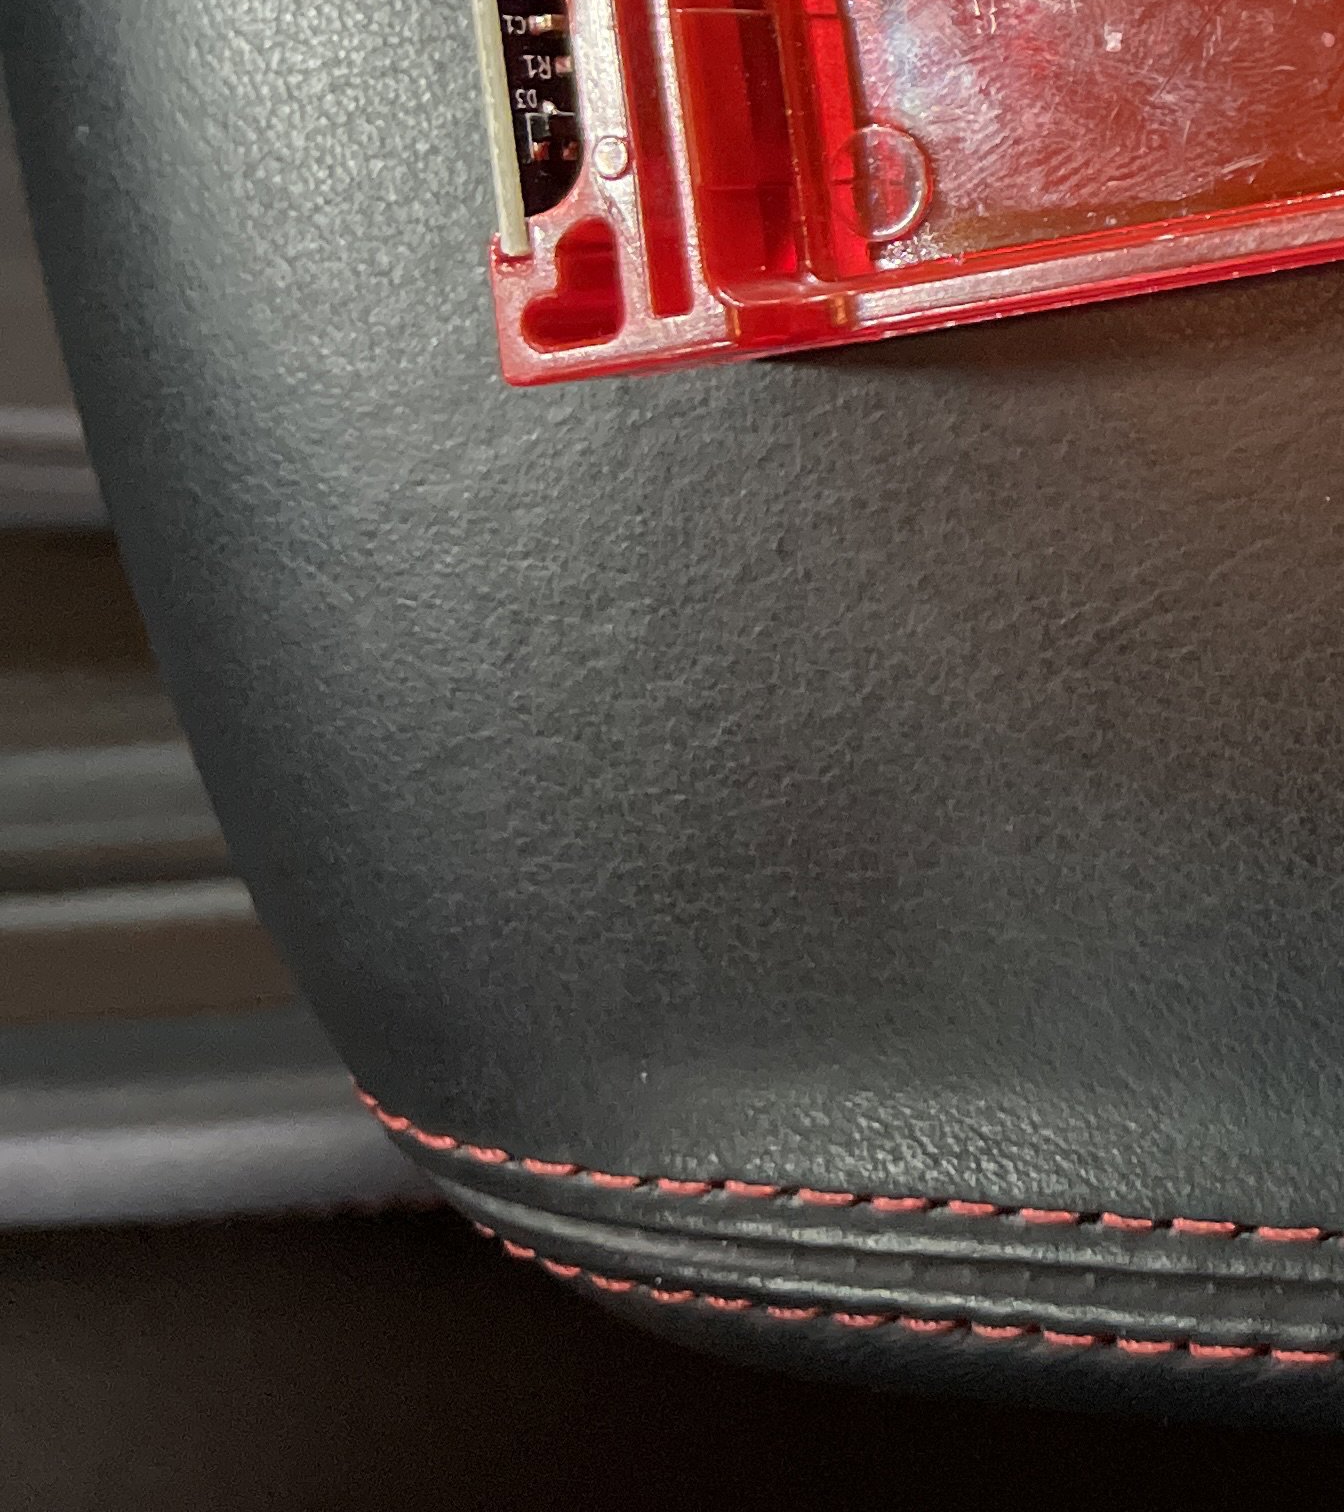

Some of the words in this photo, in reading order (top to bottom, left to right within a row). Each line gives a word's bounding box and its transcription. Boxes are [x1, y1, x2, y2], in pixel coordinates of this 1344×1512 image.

[502, 15, 526, 35] C1
[523, 55, 551, 80] R1
[515, 89, 537, 109] D3
